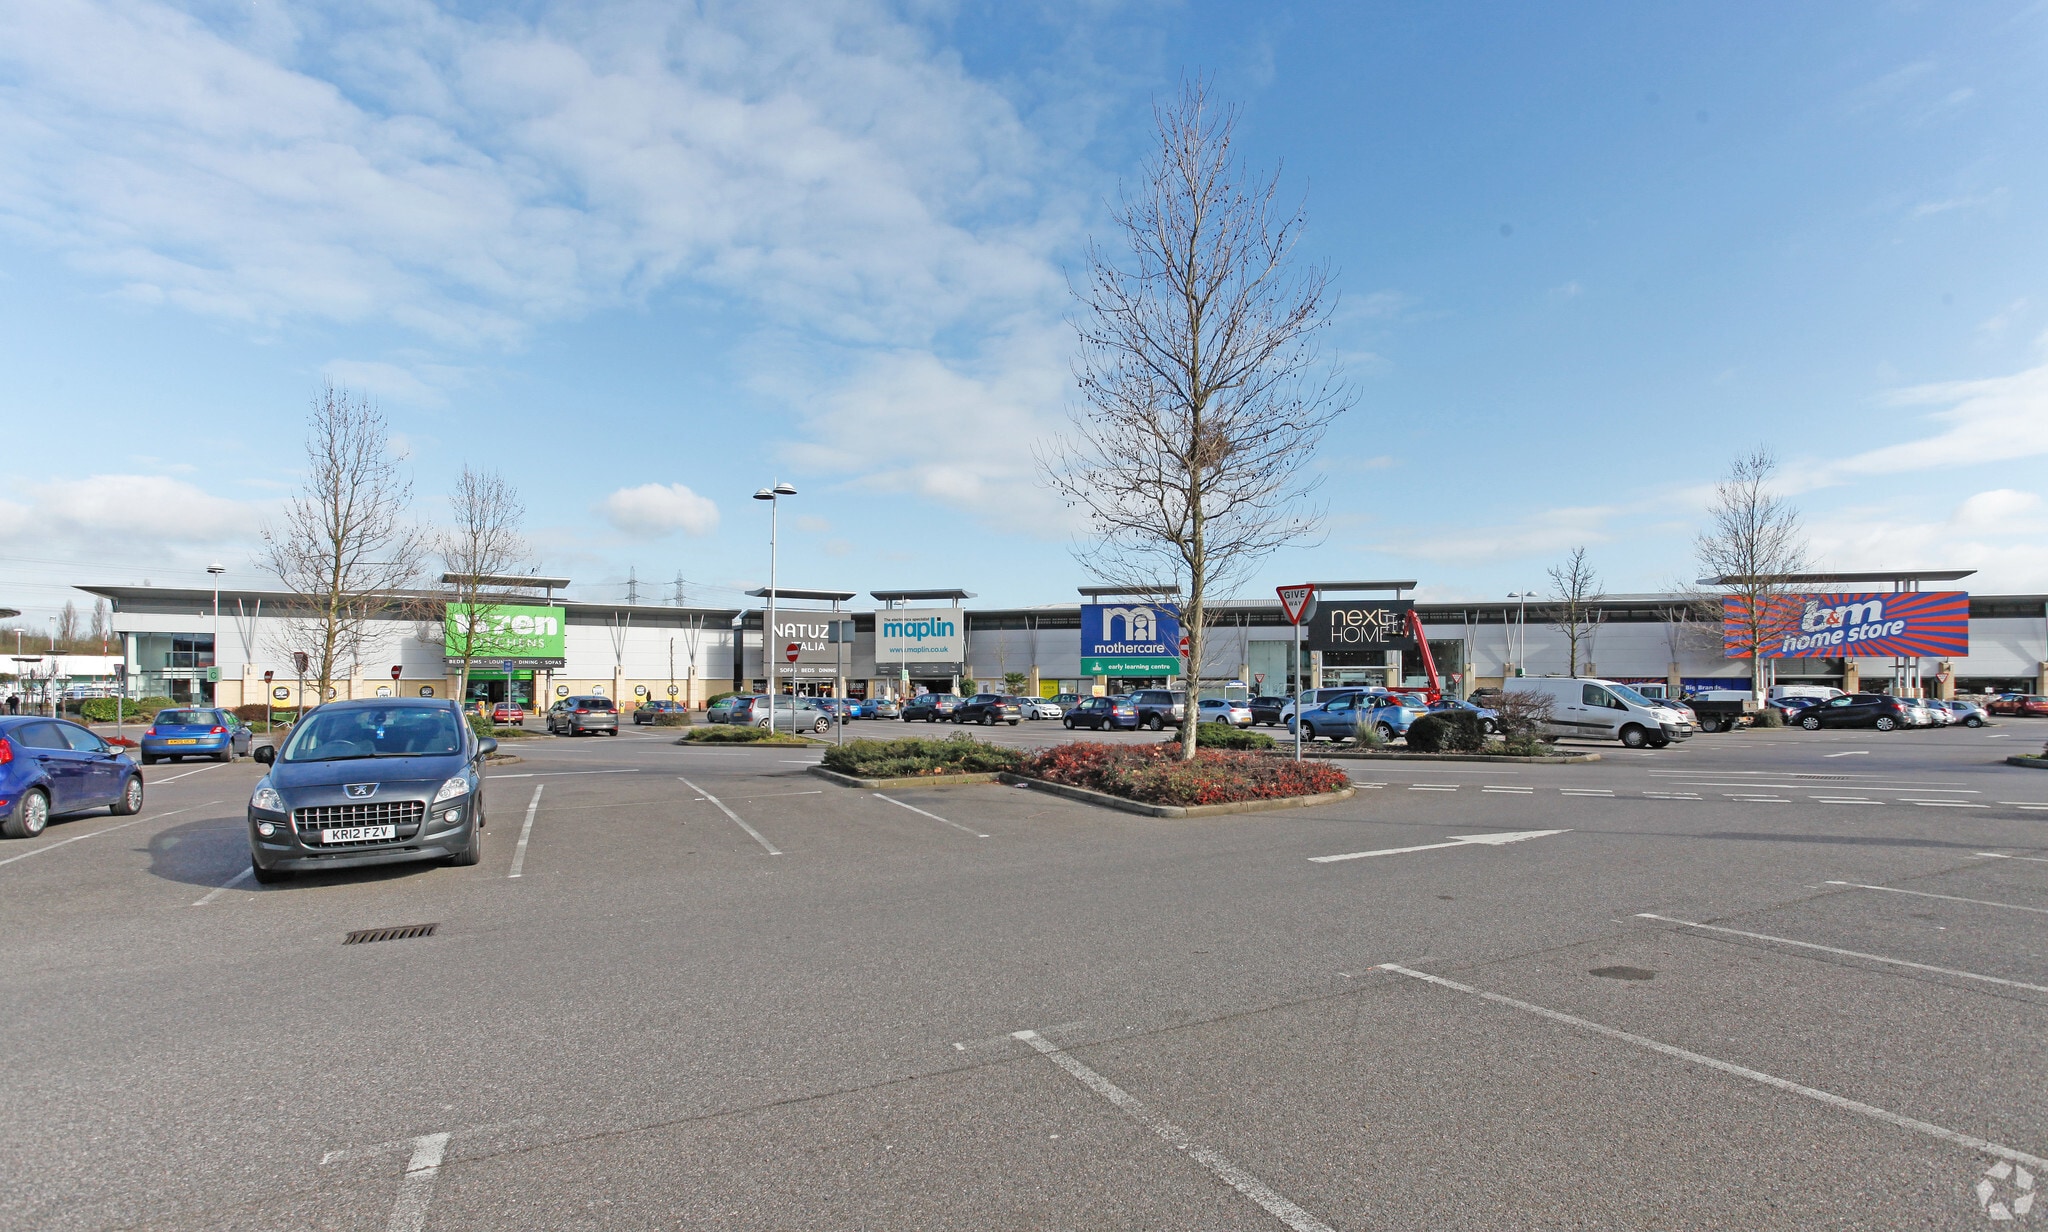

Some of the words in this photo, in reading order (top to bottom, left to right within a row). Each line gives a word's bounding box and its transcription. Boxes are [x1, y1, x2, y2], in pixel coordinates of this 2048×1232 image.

[1284, 590, 1305, 599] GIVE
[1331, 608, 1390, 626] next
[774, 623, 829, 638] NATUZ
[883, 616, 955, 642] maplin
[1331, 626, 1390, 643] HOME
[1782, 629, 1845, 652] home
[1847, 620, 1905, 642] store
[791, 641, 826, 651] ALIA
[1094, 641, 1165, 653] mothercare
[332, 828, 361, 841] KR12
[363, 826, 388, 838] FZV
